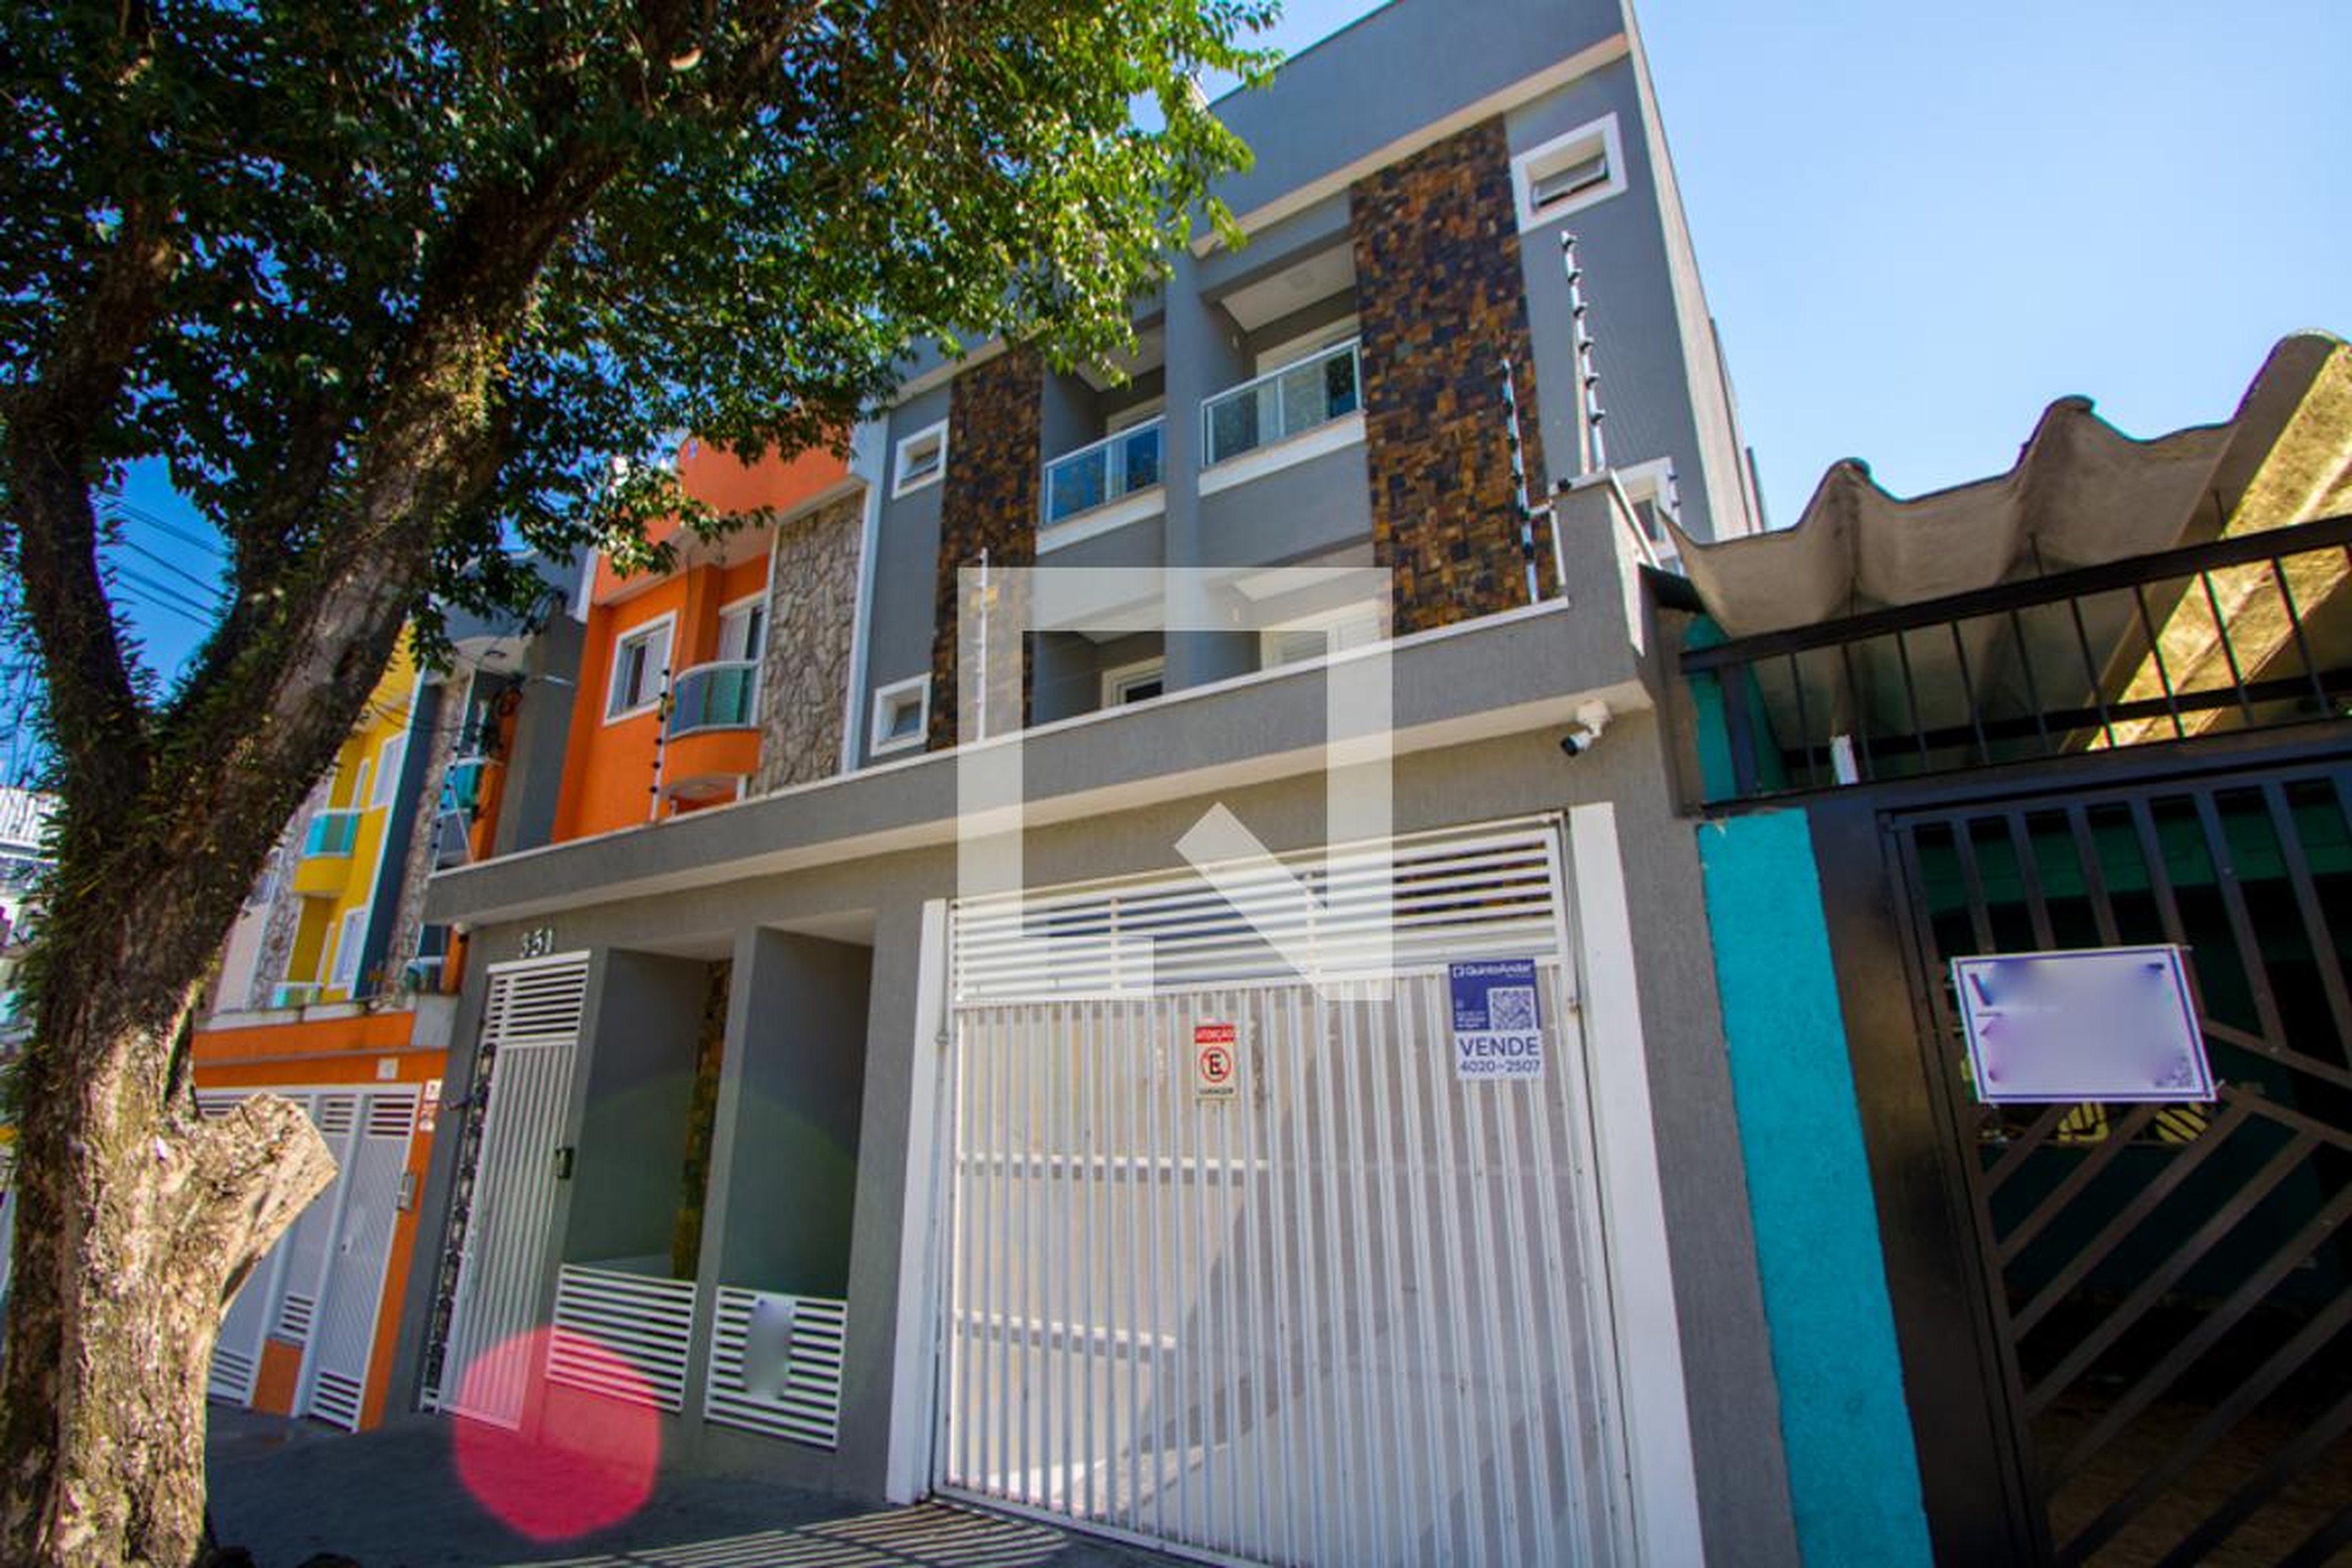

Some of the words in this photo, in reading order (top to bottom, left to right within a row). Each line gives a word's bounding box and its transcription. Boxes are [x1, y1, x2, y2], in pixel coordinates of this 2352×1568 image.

[1458, 1036, 1540, 1057] VENDE
[1208, 1053, 1223, 1075] E
[1461, 1059, 1540, 1073] 4020-2507
